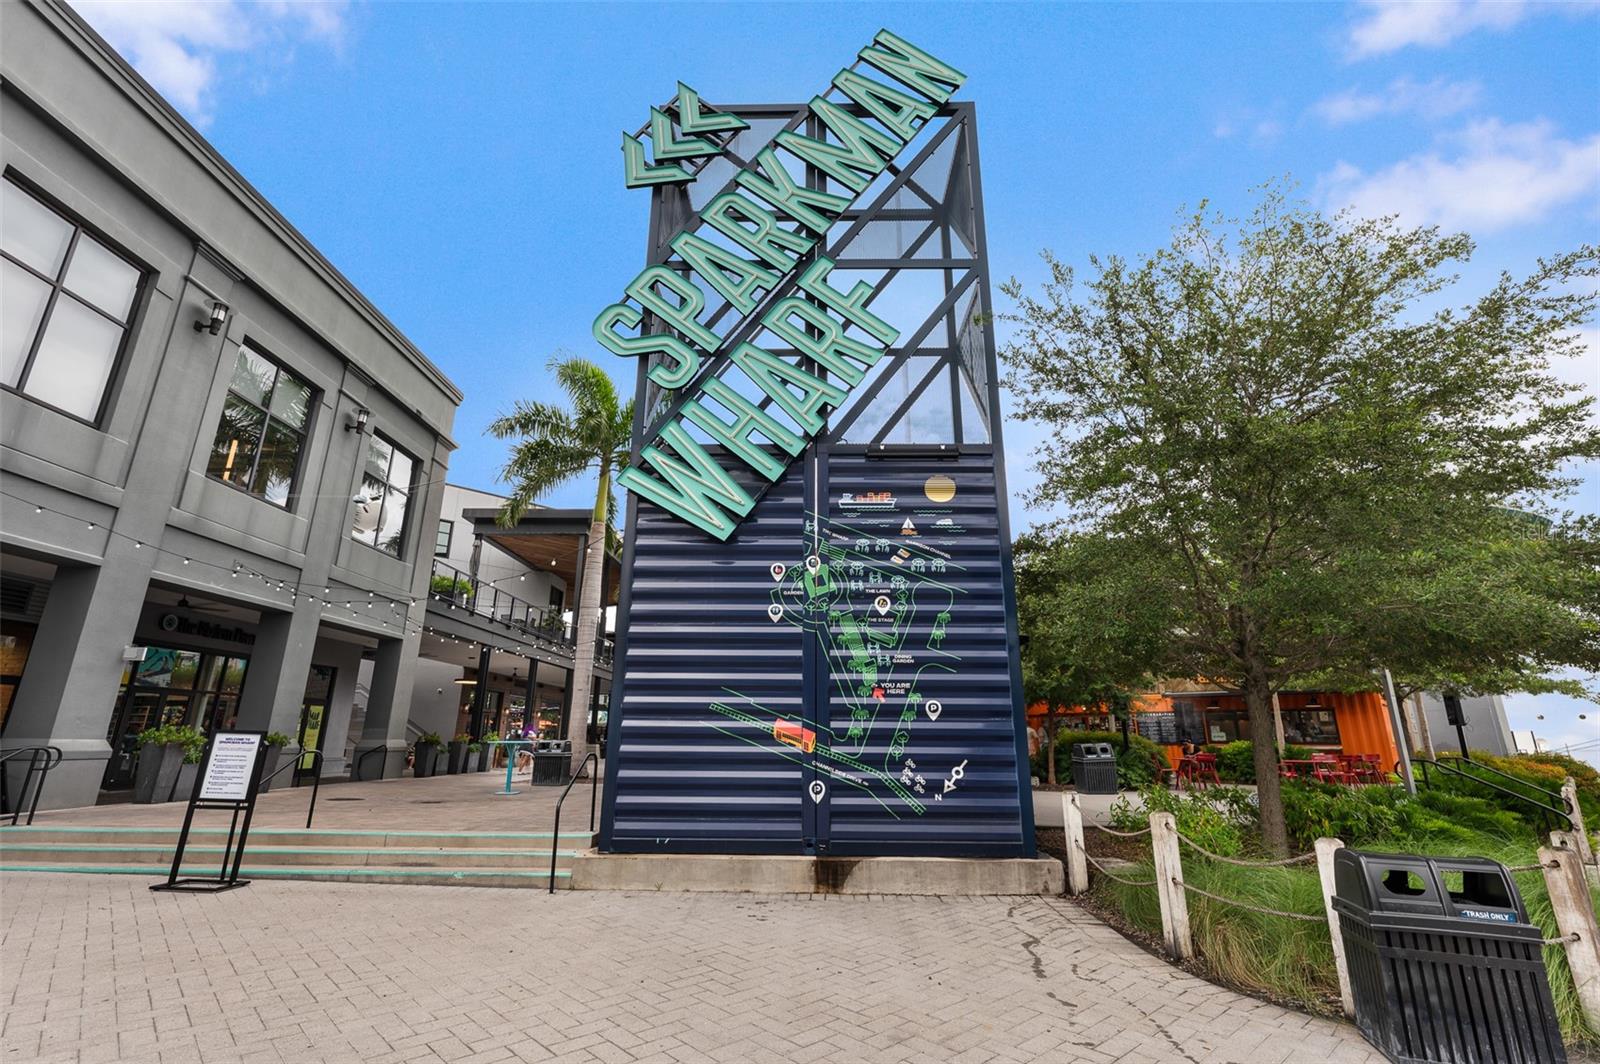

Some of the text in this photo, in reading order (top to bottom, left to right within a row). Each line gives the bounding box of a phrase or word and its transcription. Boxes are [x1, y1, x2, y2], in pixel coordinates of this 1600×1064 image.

[592, 28, 968, 390] SPARKMAN
[616, 255, 901, 543] WHARF
[934, 793, 943, 801] N
[1463, 910, 1510, 921] TRASH ONLY
